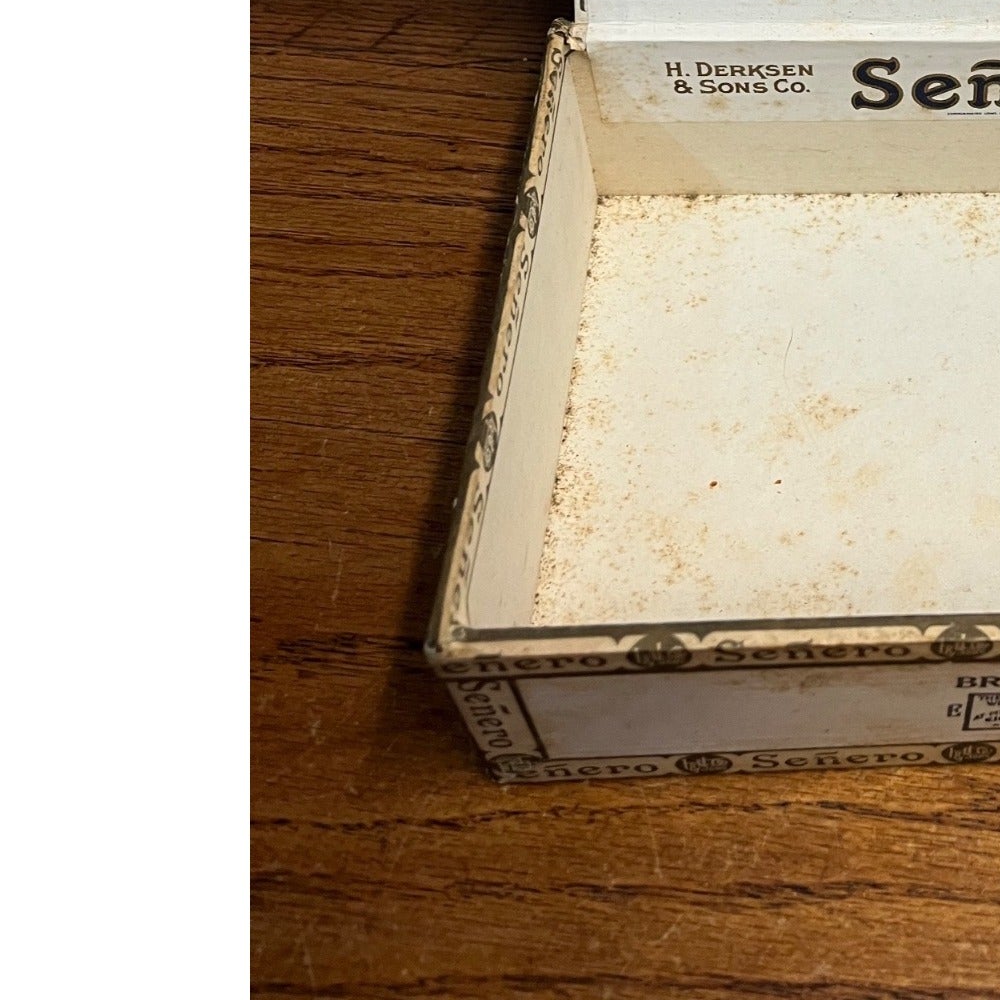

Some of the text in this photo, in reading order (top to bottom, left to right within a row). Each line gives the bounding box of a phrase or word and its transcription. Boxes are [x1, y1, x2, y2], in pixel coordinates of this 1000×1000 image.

[665, 61, 814, 79] H. DERKSEN
[673, 80, 693, 94] &
[714, 638, 911, 663] Señero
[752, 750, 925, 770] Señero
